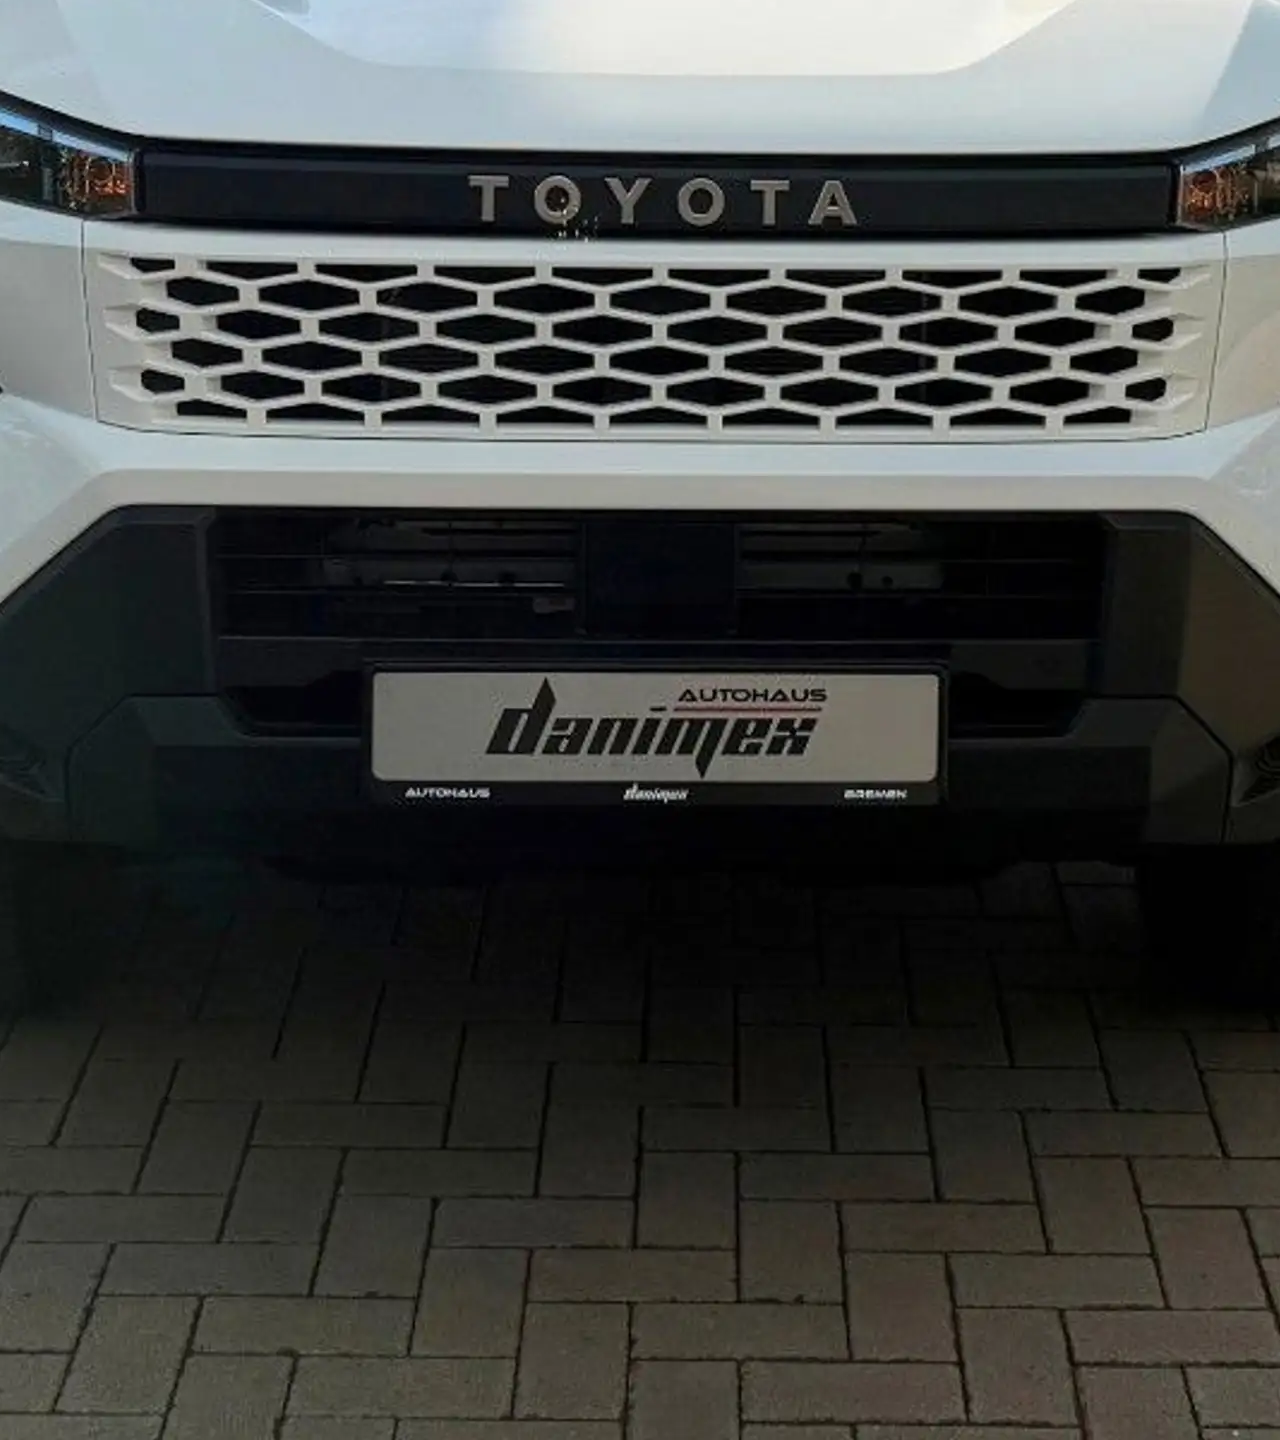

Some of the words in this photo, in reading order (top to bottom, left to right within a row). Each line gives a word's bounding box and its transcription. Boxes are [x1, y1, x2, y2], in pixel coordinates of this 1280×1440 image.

[468, 174, 857, 227] TOYOTA
[677, 687, 828, 703] AUTOHAUS
[485, 677, 819, 779] danimex
[404, 786, 491, 799] AUTOHAUS
[842, 788, 908, 799] BREMEN
